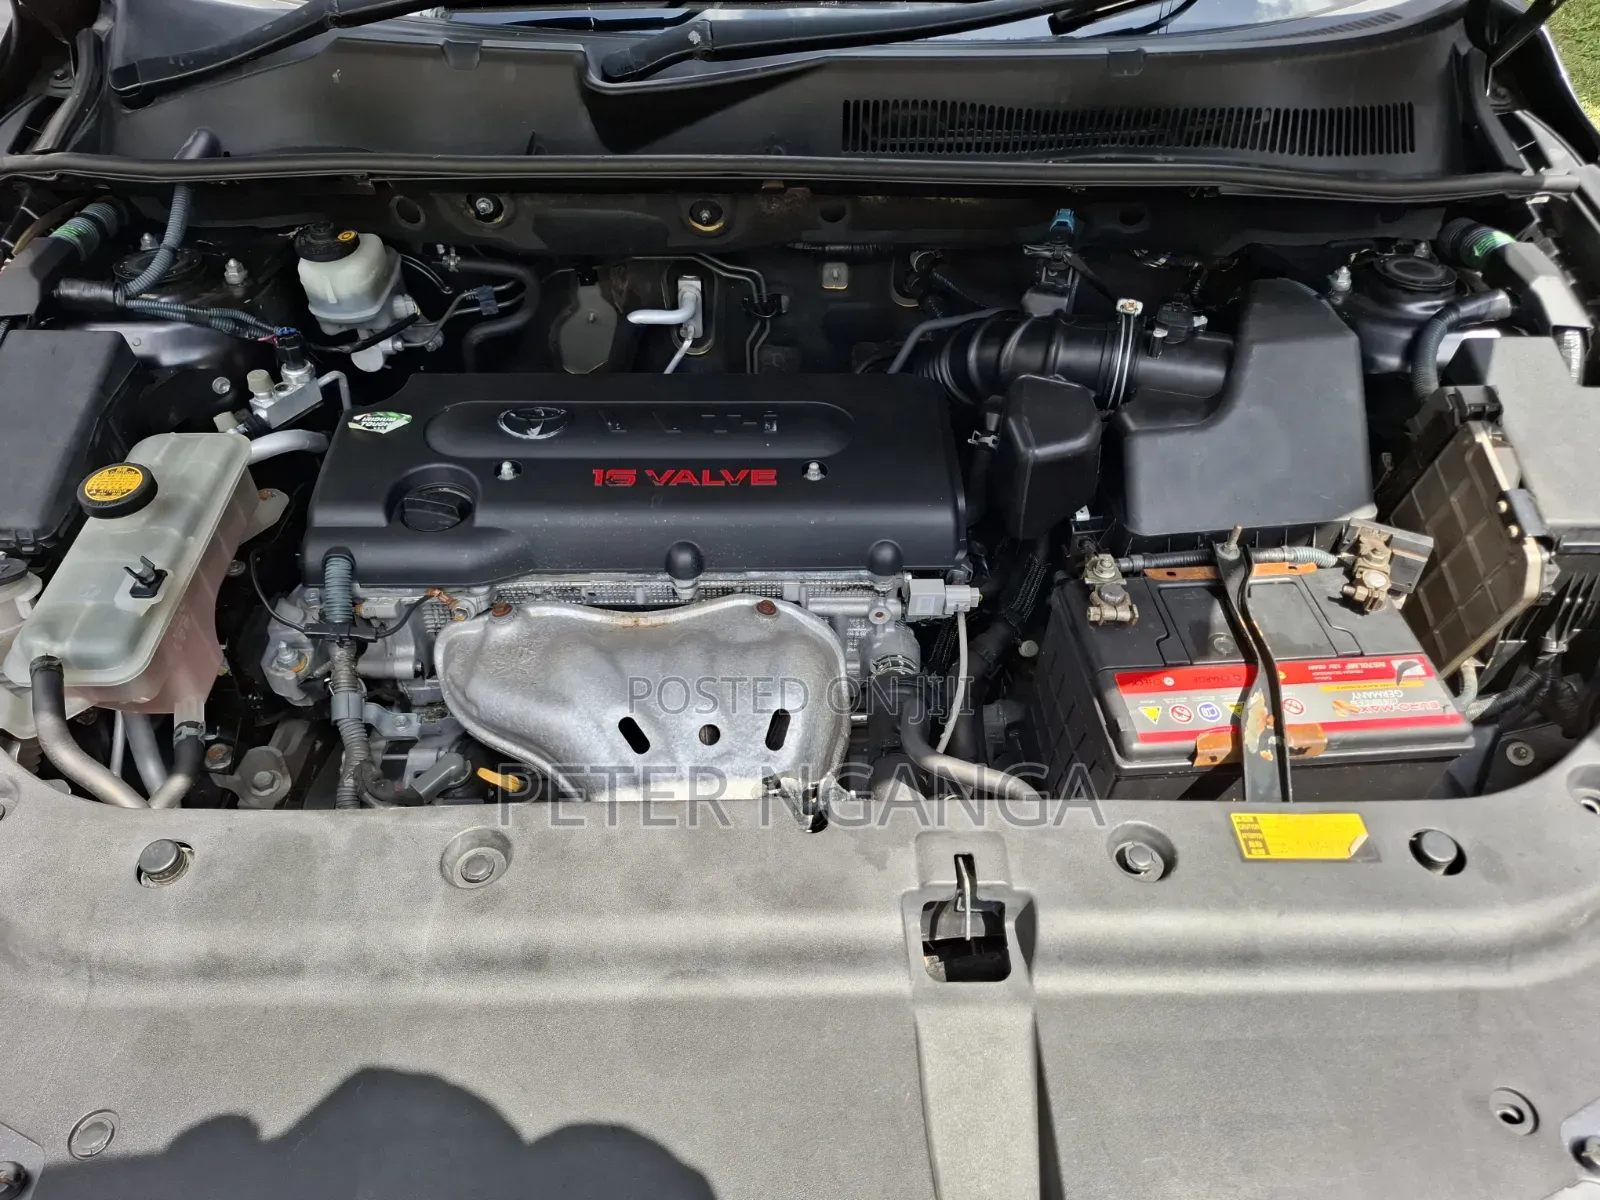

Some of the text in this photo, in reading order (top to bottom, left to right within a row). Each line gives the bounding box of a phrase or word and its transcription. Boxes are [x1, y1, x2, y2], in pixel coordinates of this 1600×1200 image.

[592, 468, 777, 487] 16 VALVE
[1131, 678, 1162, 687] CHECK
[1191, 674, 1230, 684] CHARGE
[1351, 689, 1404, 700] GERMANY
[1358, 700, 1440, 714] EURO-MAX
